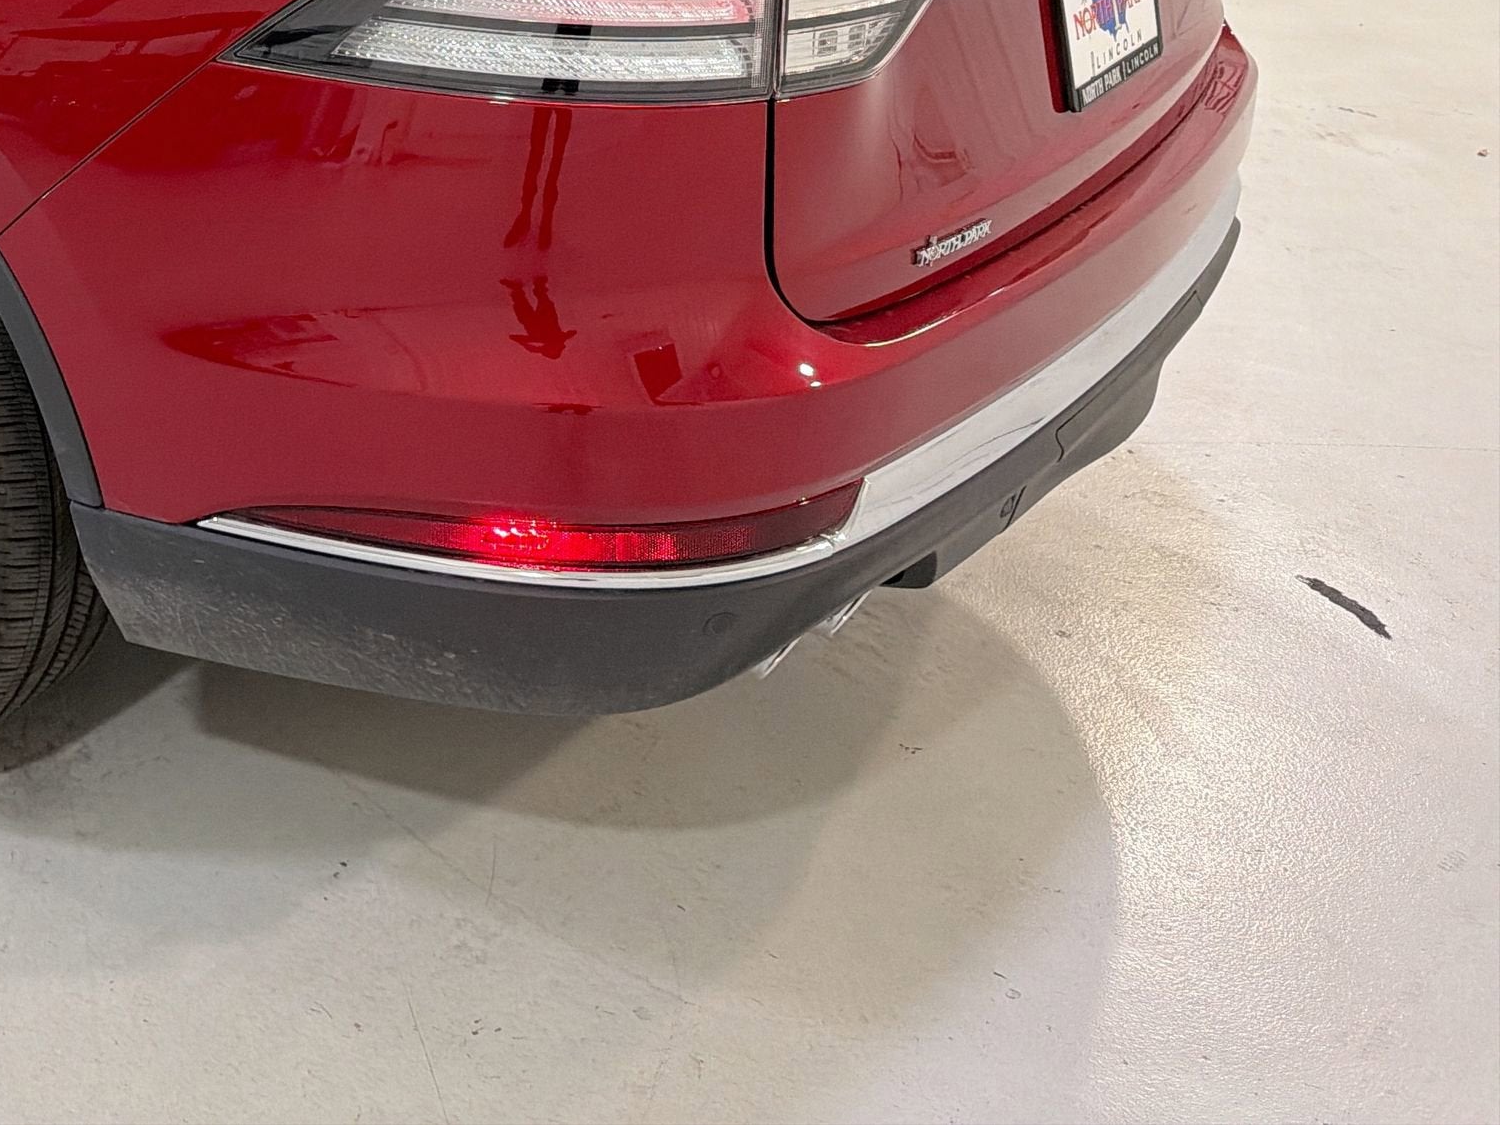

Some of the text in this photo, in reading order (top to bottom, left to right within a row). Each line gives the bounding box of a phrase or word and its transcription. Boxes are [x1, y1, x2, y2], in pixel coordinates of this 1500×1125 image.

[1096, 30, 1143, 70] LINCOLN
[1081, 42, 1159, 107] NORTH PARK LINCOLN
[916, 220, 993, 267] NORTH PARK
